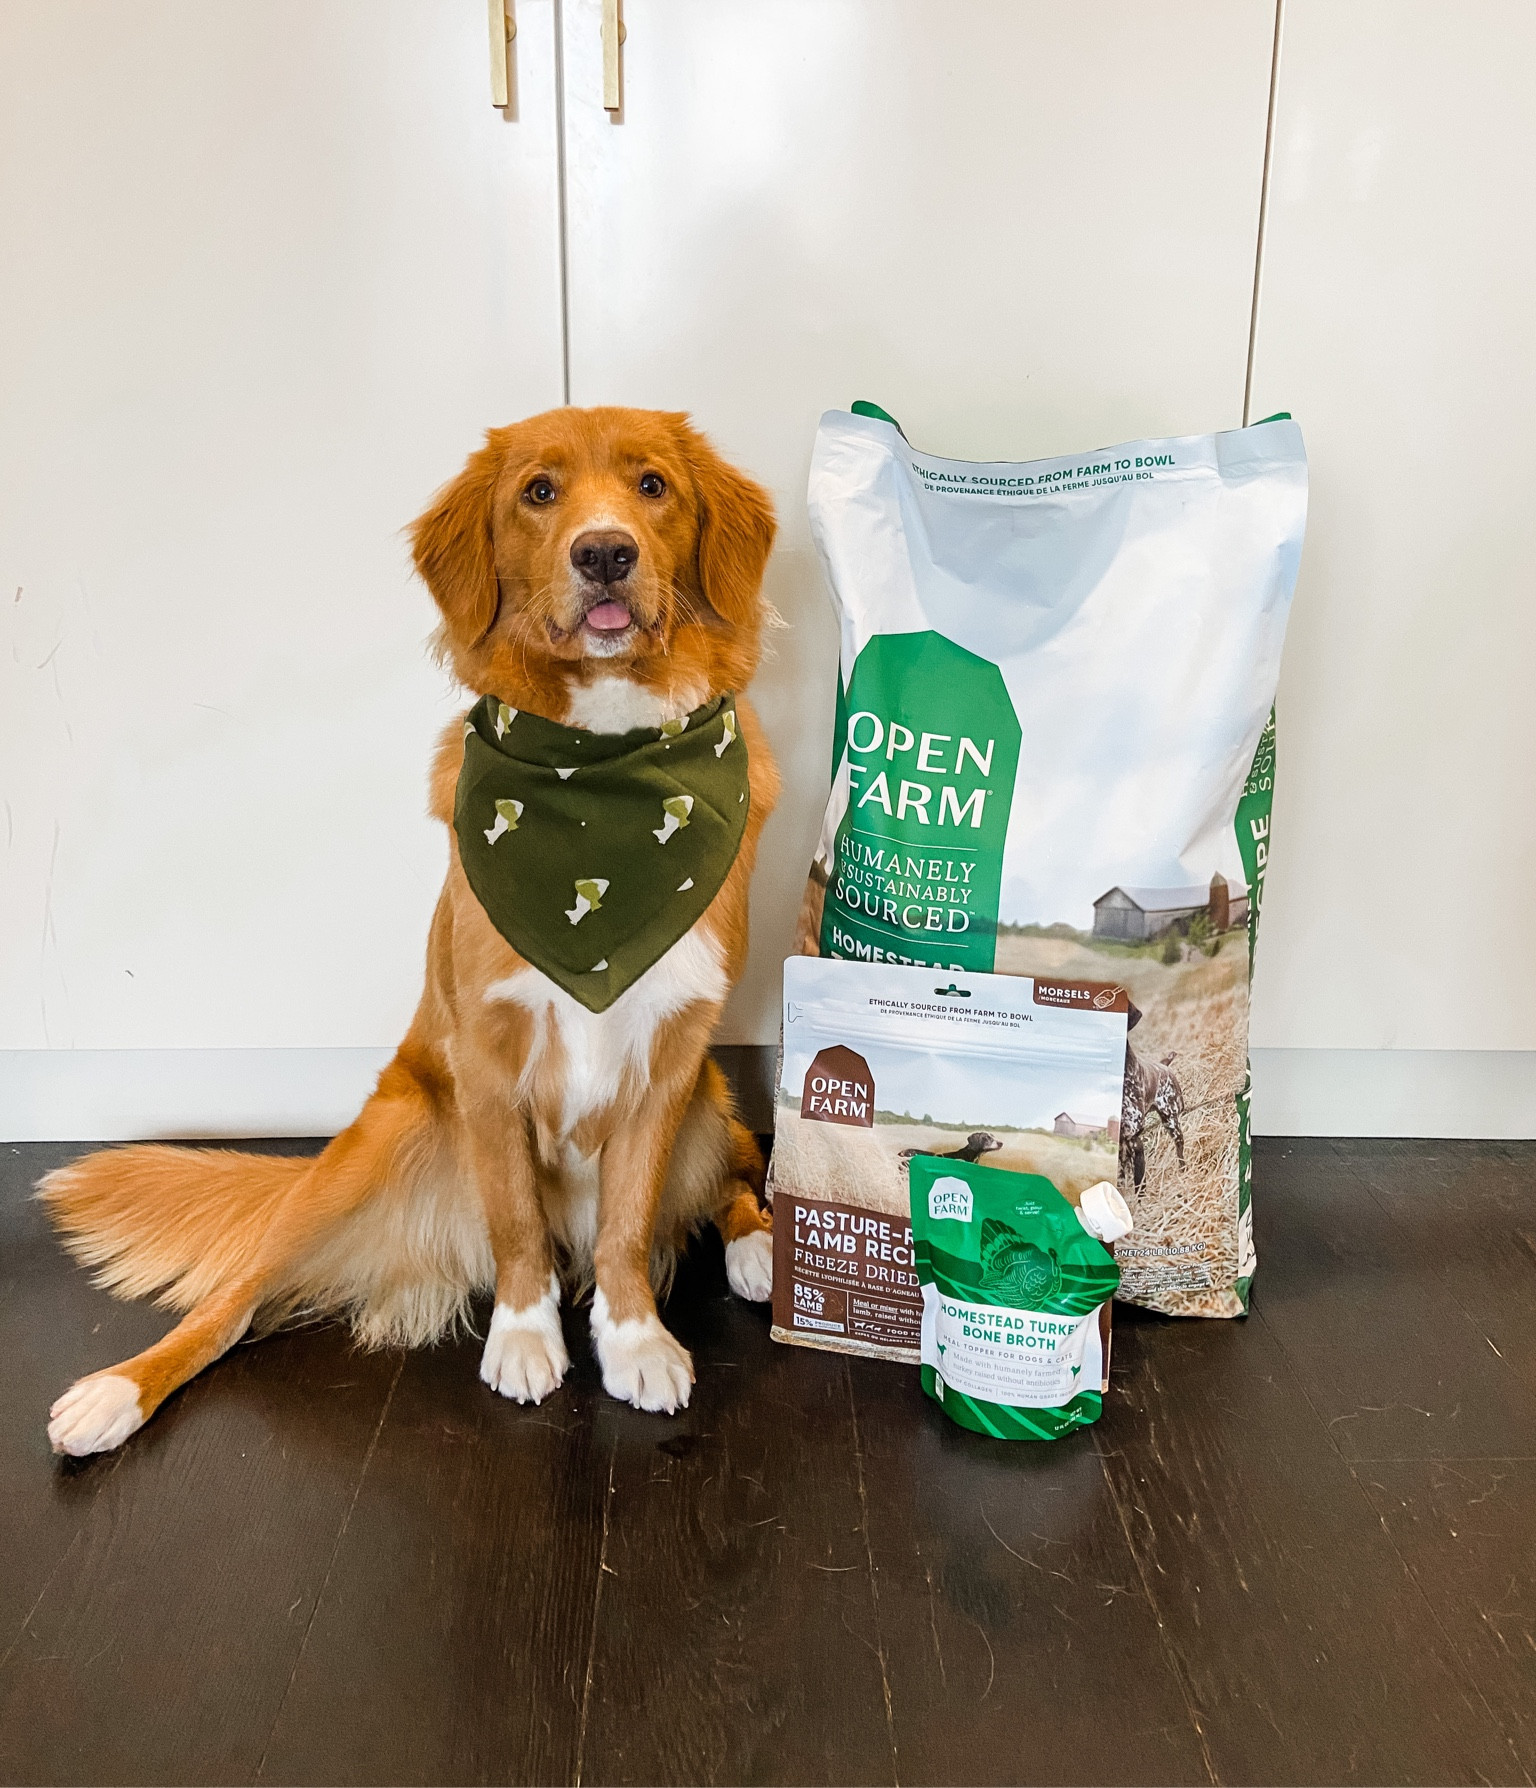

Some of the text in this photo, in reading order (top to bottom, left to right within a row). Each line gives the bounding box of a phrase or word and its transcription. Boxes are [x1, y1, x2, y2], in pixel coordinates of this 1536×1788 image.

[911, 455, 1175, 487] ETHICALLY SOURCED FROM FARM TO BOWL
[924, 472, 1154, 496] DE PROVENANCE ÉTHIQUE DE LA FERME JUSQU'AU BOL
[847, 711, 995, 777] OPEN
[840, 833, 976, 883] HUMANELY
[846, 864, 973, 905] SUSTAINABLY
[1038, 985, 1091, 1000] MORSELS
[869, 998, 1033, 1022] ETHICALLY SOURCED FROM FARM TO BOWL
[888, 1010, 923, 1018] PROVENANCE
[811, 1077, 868, 1099] OPEN
[933, 1192, 969, 1204] OPEN
[934, 1204, 967, 1216] FARM
[794, 1225, 916, 1267] LAMB RECI
[1121, 1249, 1138, 1257] NET
[1139, 1249, 1150, 1257] 24
[1152, 1248, 1163, 1256] LB
[1191, 1242, 1206, 1252] KG)
[794, 1247, 920, 1287] FREEZE DRIED
[794, 1283, 825, 1304] 85%
[867, 1284, 884, 1292] BASE
[794, 1295, 823, 1312] LAMB
[899, 1308, 915, 1316] with
[796, 1316, 813, 1327] 15%
[874, 1312, 897, 1321] raised
[941, 1303, 1078, 1336] HOMESTEAD TURKE
[887, 1328, 909, 1336] FOOD
[963, 1325, 1056, 1351] BONE BROTH
[963, 1343, 995, 1356] TOPPER
[1018, 1355, 1043, 1364] DOGS
[1055, 1352, 1073, 1363] CATS
[953, 1352, 1061, 1377] Made with humanely farmed
[974, 1371, 995, 1380] raised
[997, 1375, 1024, 1386] without
